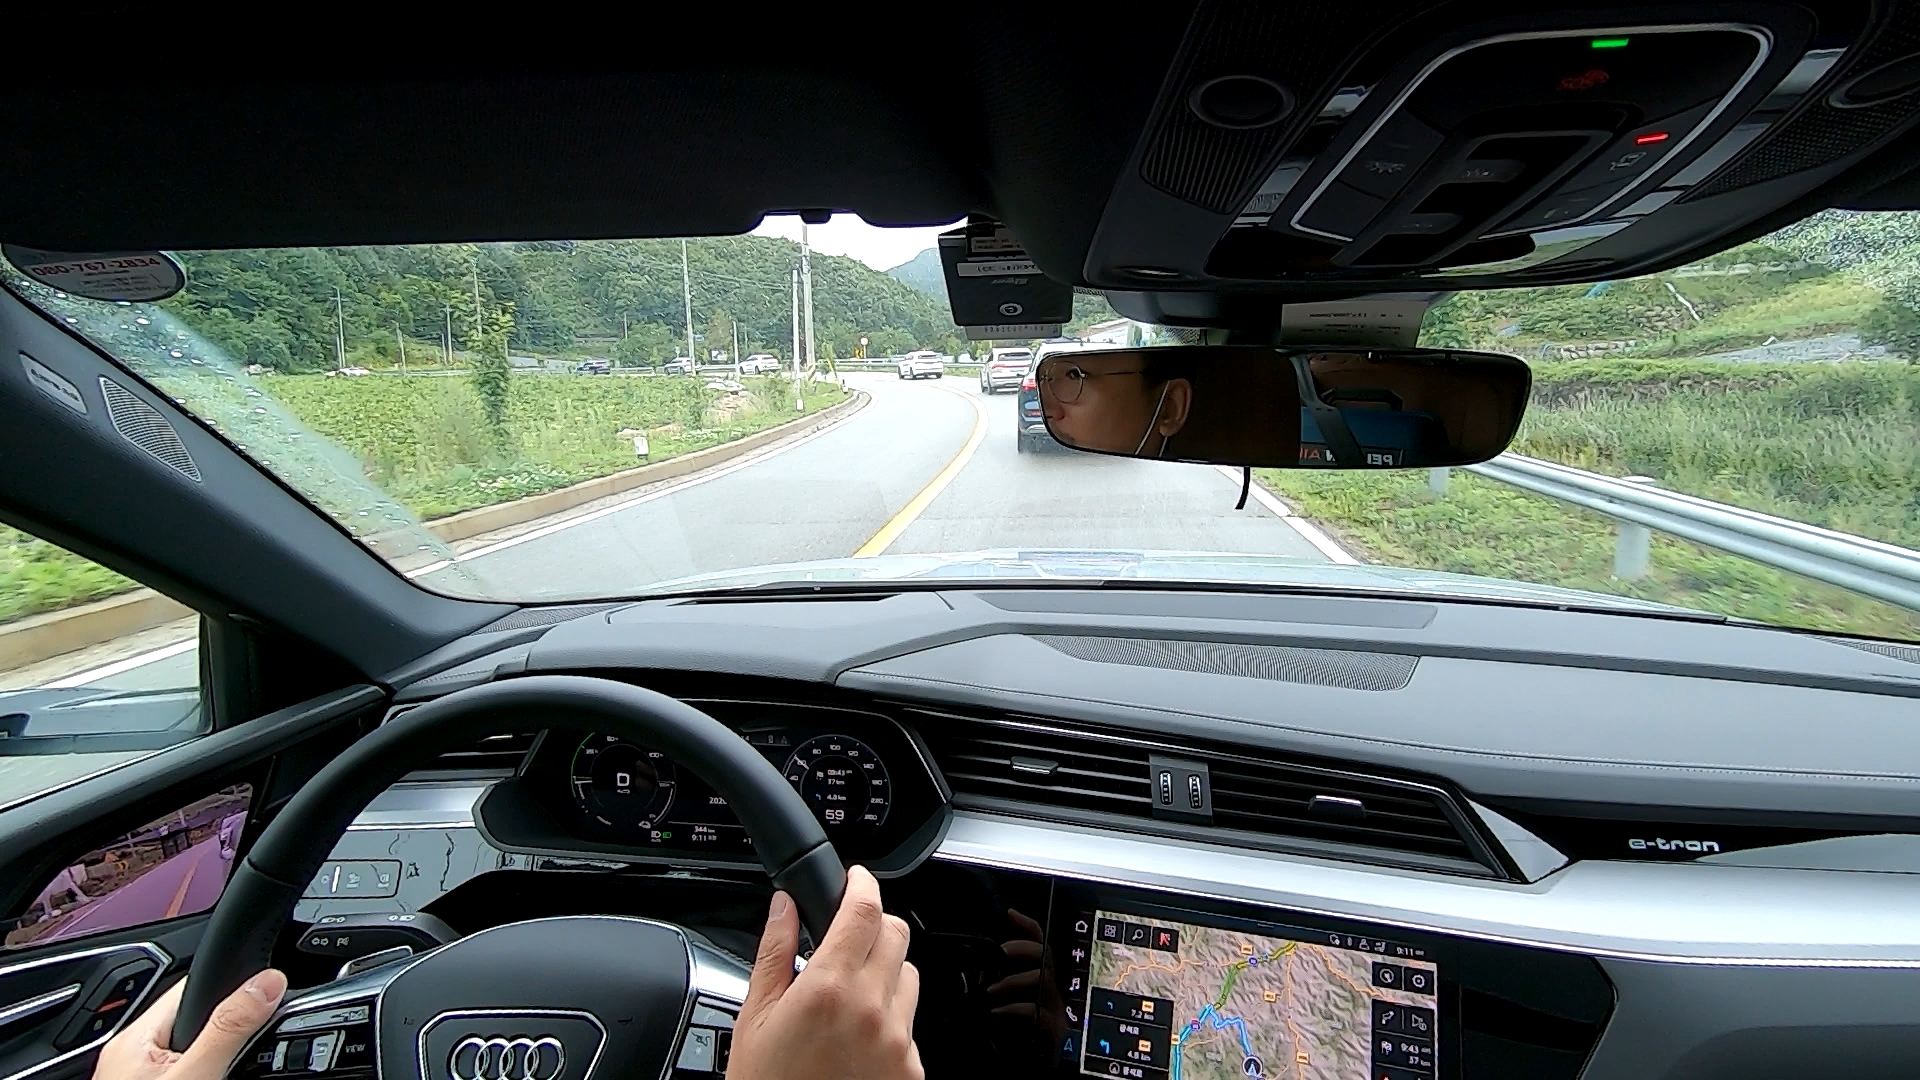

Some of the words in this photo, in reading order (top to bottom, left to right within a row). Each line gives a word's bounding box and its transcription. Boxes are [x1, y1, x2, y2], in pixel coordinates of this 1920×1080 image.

[616, 772, 630, 787] D
[825, 809, 845, 820] 59
[1628, 837, 1720, 852] e-tron
